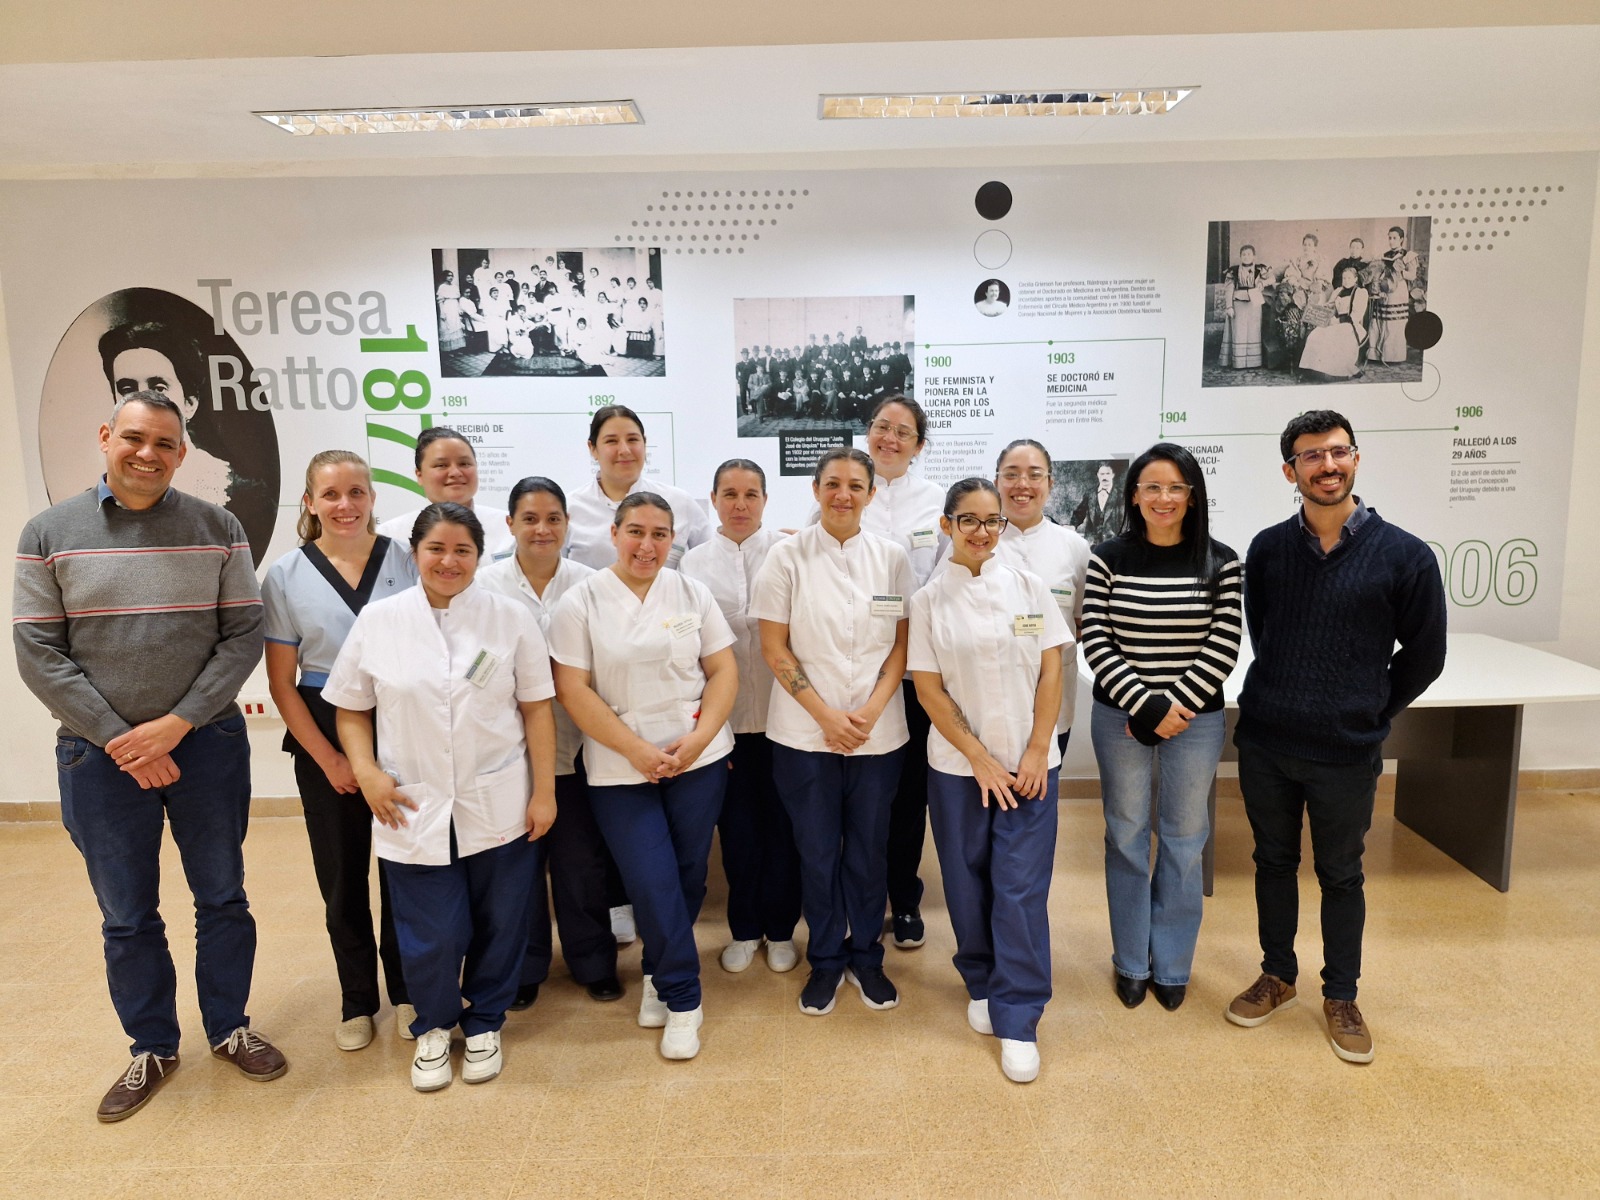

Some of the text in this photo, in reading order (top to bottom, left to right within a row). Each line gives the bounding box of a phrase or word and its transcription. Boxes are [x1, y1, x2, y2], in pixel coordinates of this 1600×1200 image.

[197, 279, 392, 336] Teresa
[925, 356, 952, 367] 1900
[1047, 352, 1075, 364] 1903
[925, 377, 939, 385] FUE
[943, 376, 986, 385] FEMINISTA
[1047, 374, 1058, 382] SE
[1061, 371, 1100, 382] DOCTORÓ
[208, 354, 358, 411] Ratto
[925, 387, 987, 396] PIONERA EN LA
[1047, 384, 1087, 393] MEDICINA
[442, 395, 468, 407] 1891
[588, 395, 615, 406] 1892
[925, 398, 990, 407] LUCHA POR LOS
[925, 409, 967, 418] DERECHOS
[970, 409, 981, 417] DE
[1159, 411, 1186, 423] 1904
[1456, 406, 1483, 418] 1906
[457, 423, 490, 432] RECIBIÓ
[1453, 436, 1491, 446] FALLECIÓ
[1501, 437, 1517, 445] LOS
[1452, 449, 1487, 459] 29 AÑOS
[1206, 467, 1216, 475] LA
